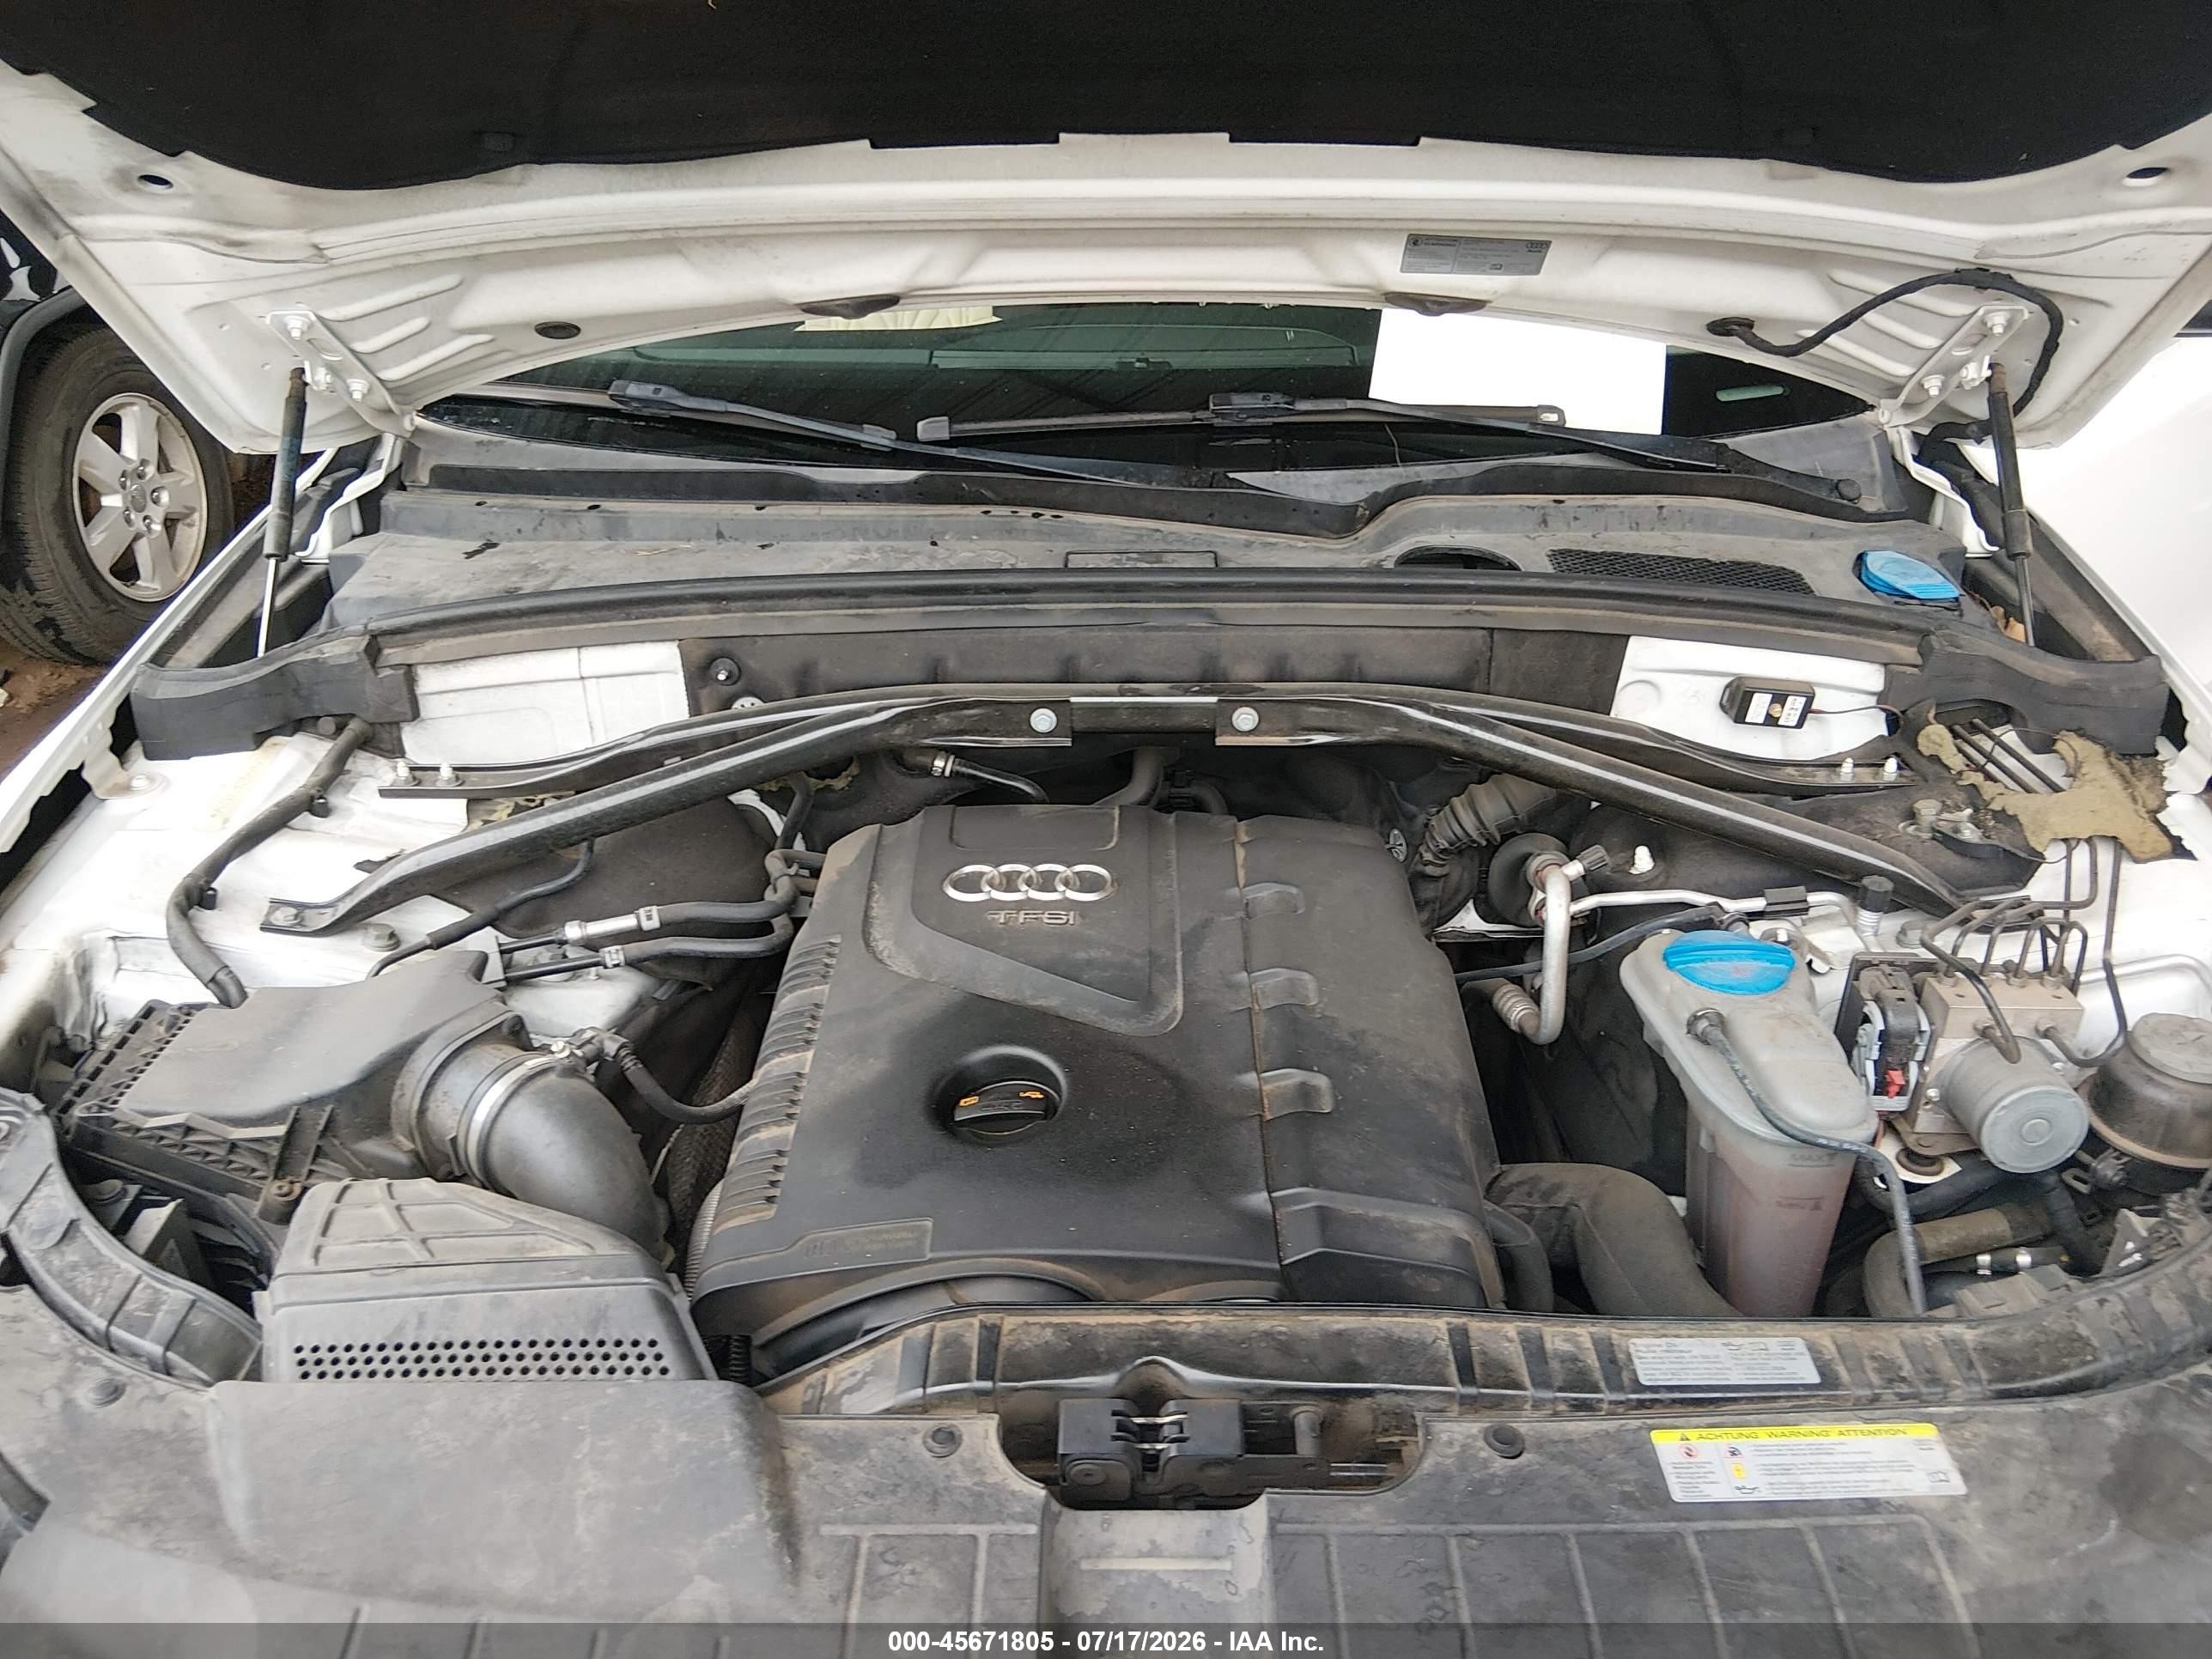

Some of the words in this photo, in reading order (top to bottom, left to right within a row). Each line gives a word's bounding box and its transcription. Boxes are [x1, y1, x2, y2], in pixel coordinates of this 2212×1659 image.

[988, 910, 1075, 926] TFSI
[1696, 1431, 1759, 1441] ACHTUNG
[1767, 1430, 1829, 1439] WARNING
[1837, 1427, 1907, 1437] ATTENTION
